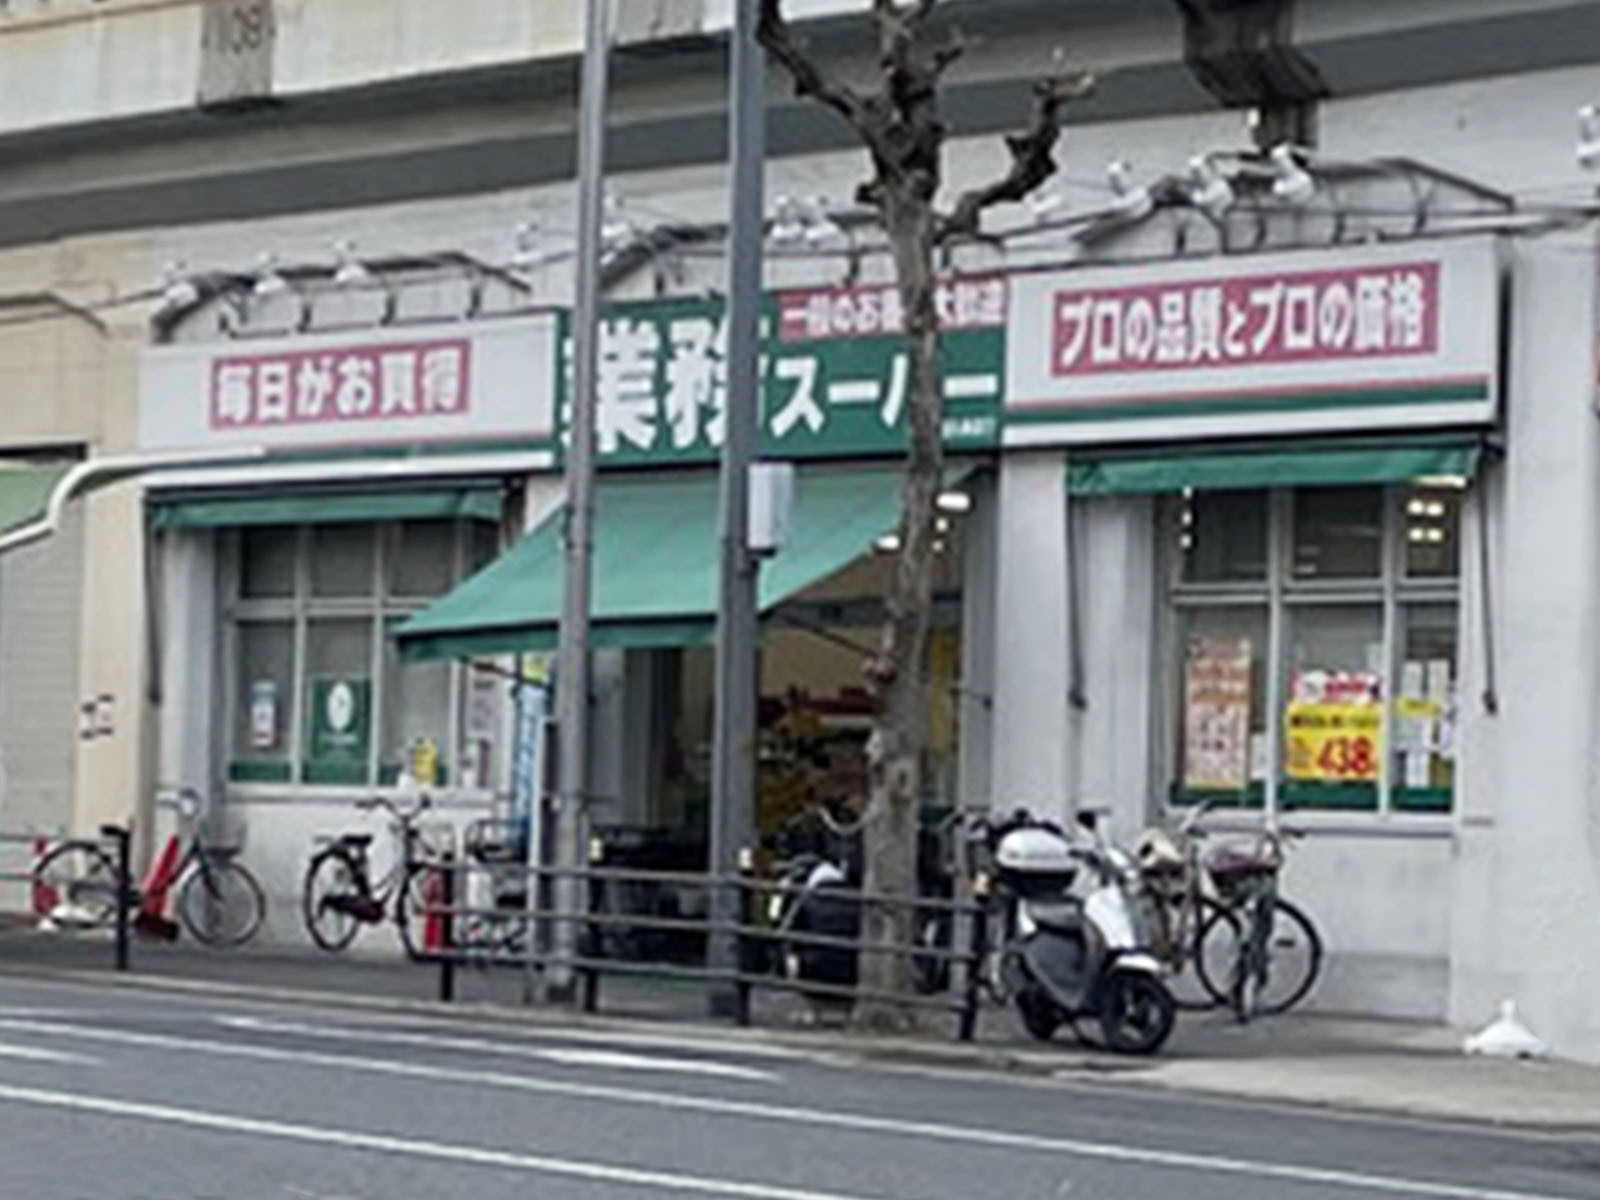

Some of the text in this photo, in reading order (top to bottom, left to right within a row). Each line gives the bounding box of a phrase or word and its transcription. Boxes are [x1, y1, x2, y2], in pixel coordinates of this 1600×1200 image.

[1060, 271, 1424, 367] プロの品質とプロの価格
[218, 347, 461, 424] 毎日がお買得
